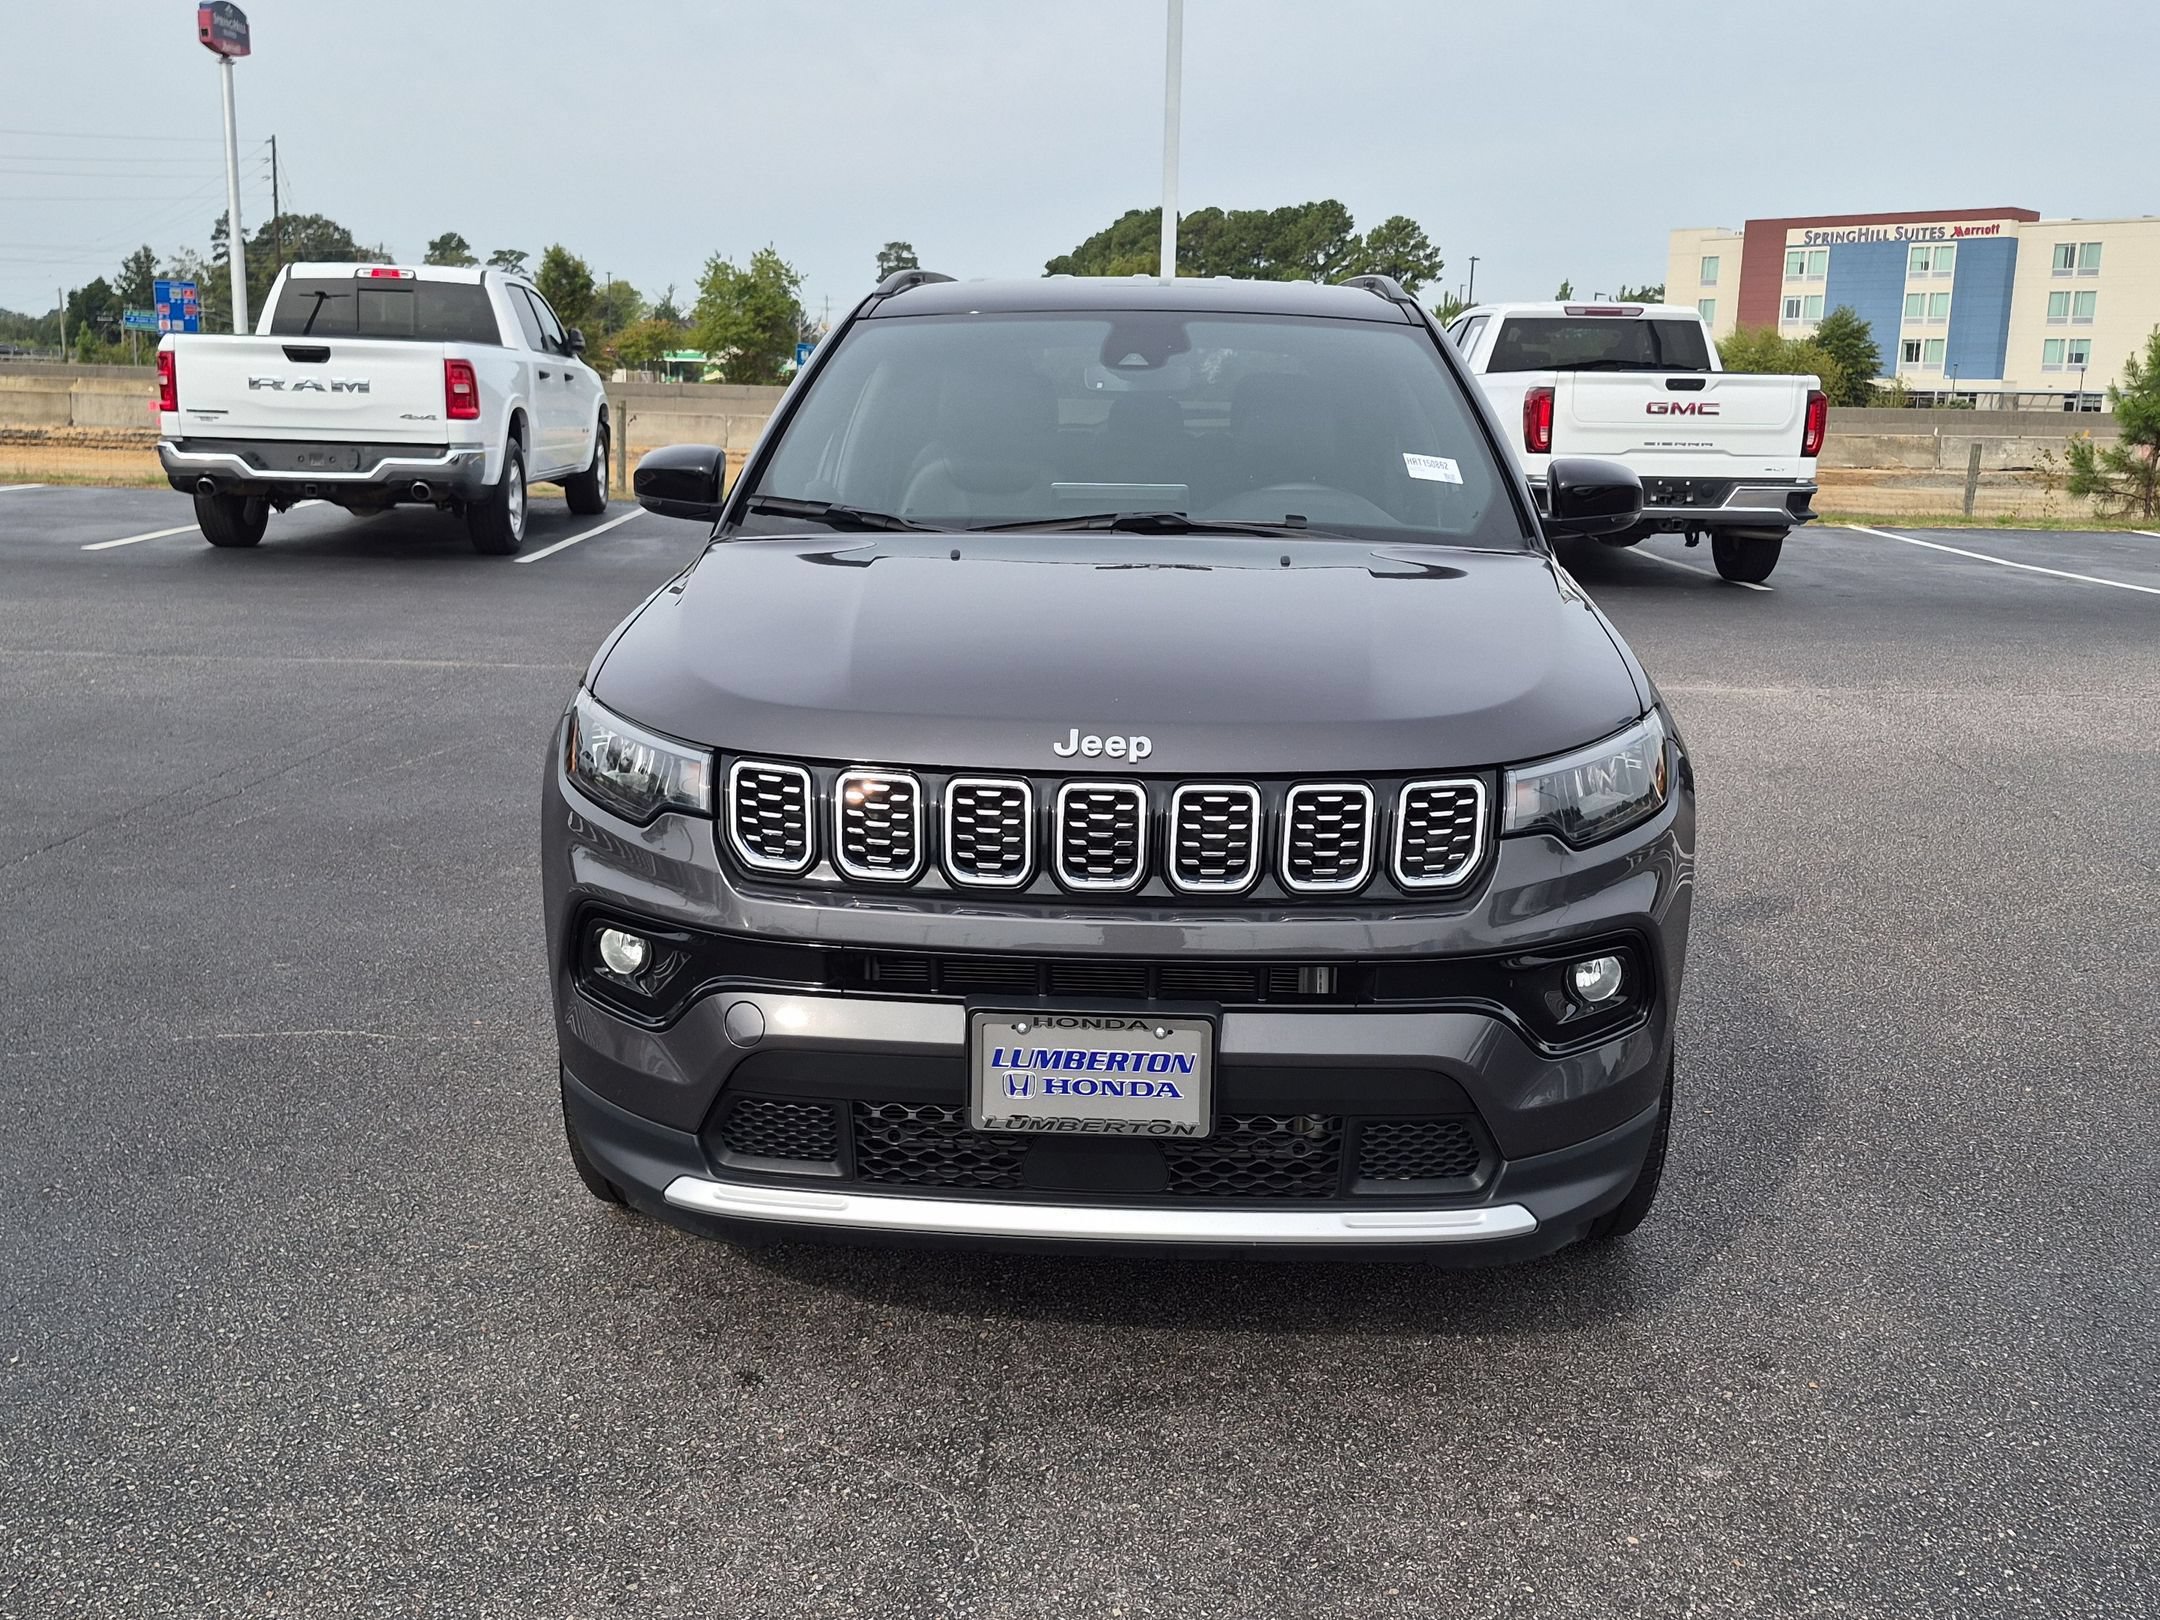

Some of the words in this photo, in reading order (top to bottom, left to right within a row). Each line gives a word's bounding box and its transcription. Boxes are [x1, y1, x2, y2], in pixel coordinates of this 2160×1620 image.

[1803, 227, 1890, 245] SPRINGHILL
[1894, 226, 1946, 241] SUITES
[1950, 224, 2001, 238] Marriott
[248, 377, 371, 394] RAM
[1646, 402, 1720, 416] GMC
[1053, 728, 1152, 764] Jeep
[1033, 1017, 1150, 1032] HONDA
[991, 1047, 1197, 1074] LUMBERTON
[1042, 1077, 1184, 1099] HONDA
[983, 1117, 1198, 1136] LUMBERTON
